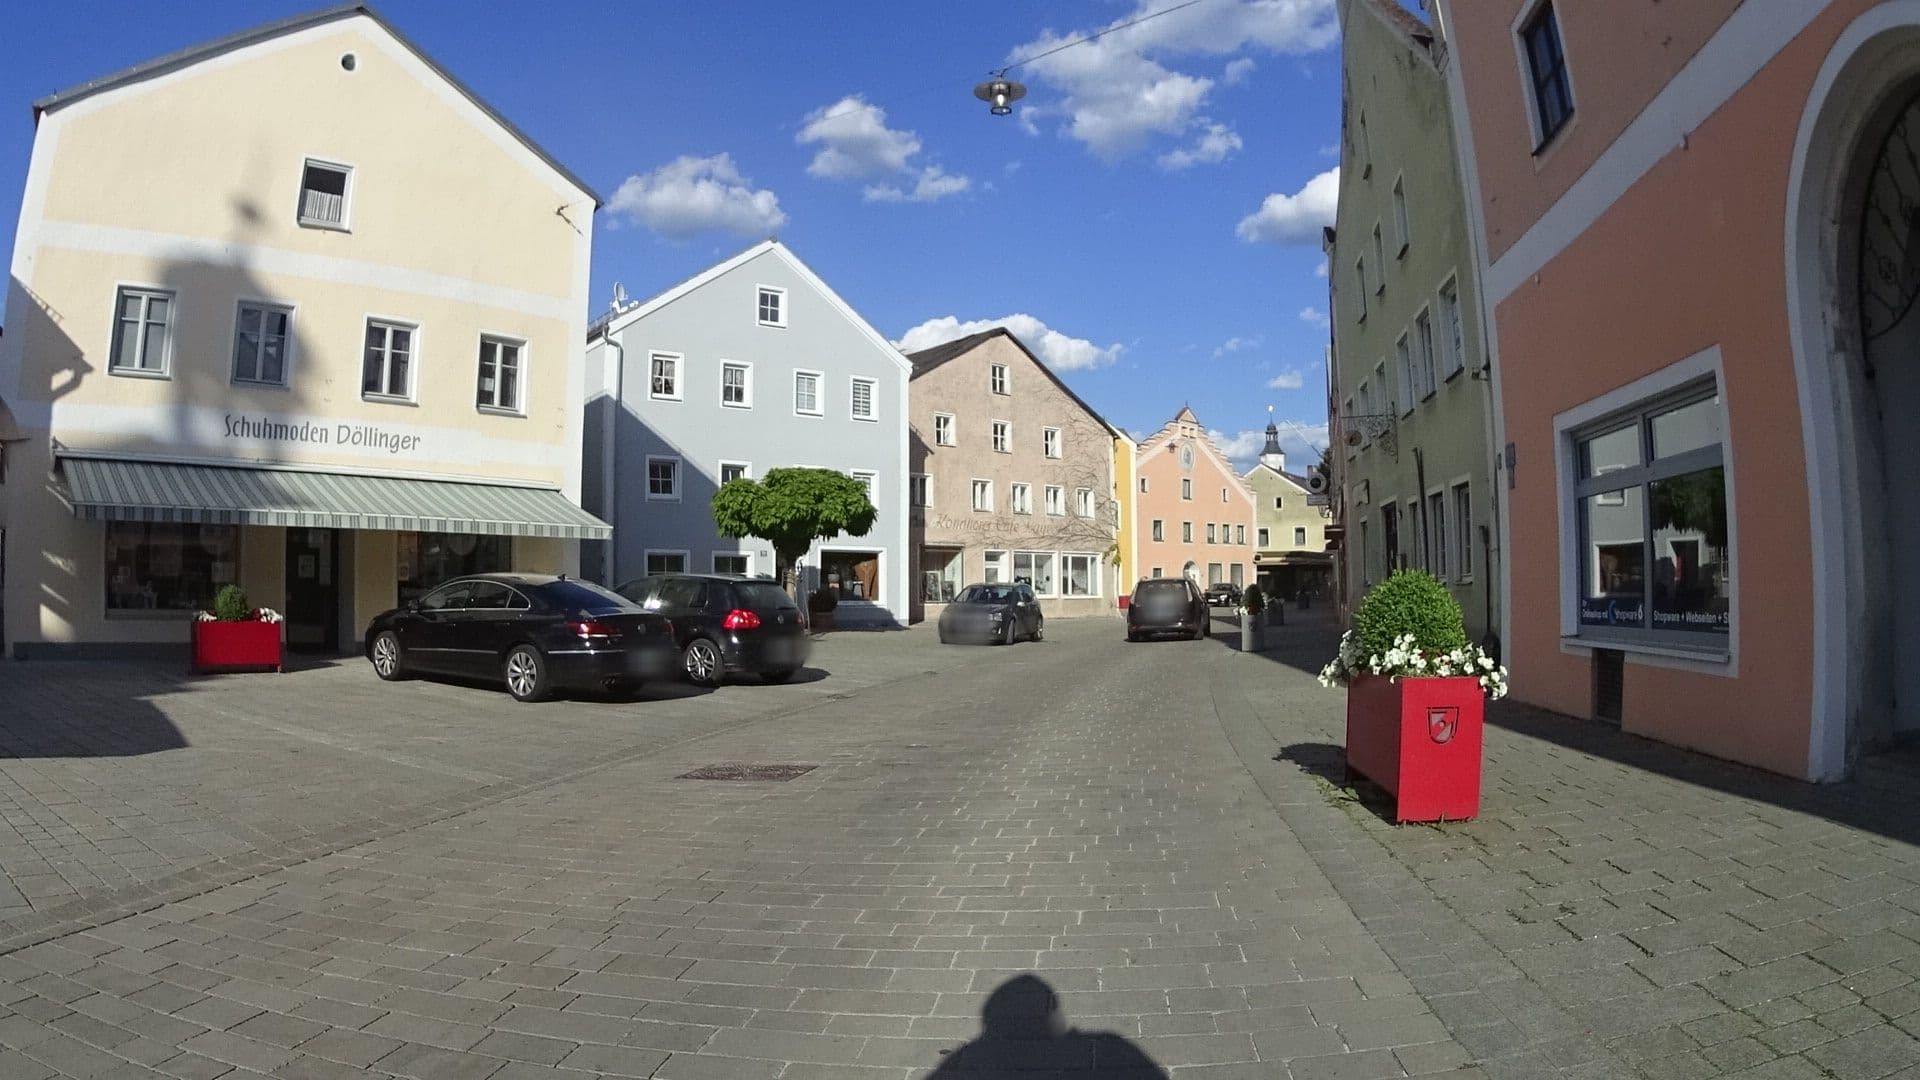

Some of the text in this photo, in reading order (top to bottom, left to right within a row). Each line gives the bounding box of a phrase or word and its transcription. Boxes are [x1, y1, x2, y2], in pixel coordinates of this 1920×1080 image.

[224, 414, 421, 454] Schuhmoden Döllinger
[1686, 610, 1717, 624] Webseiten
